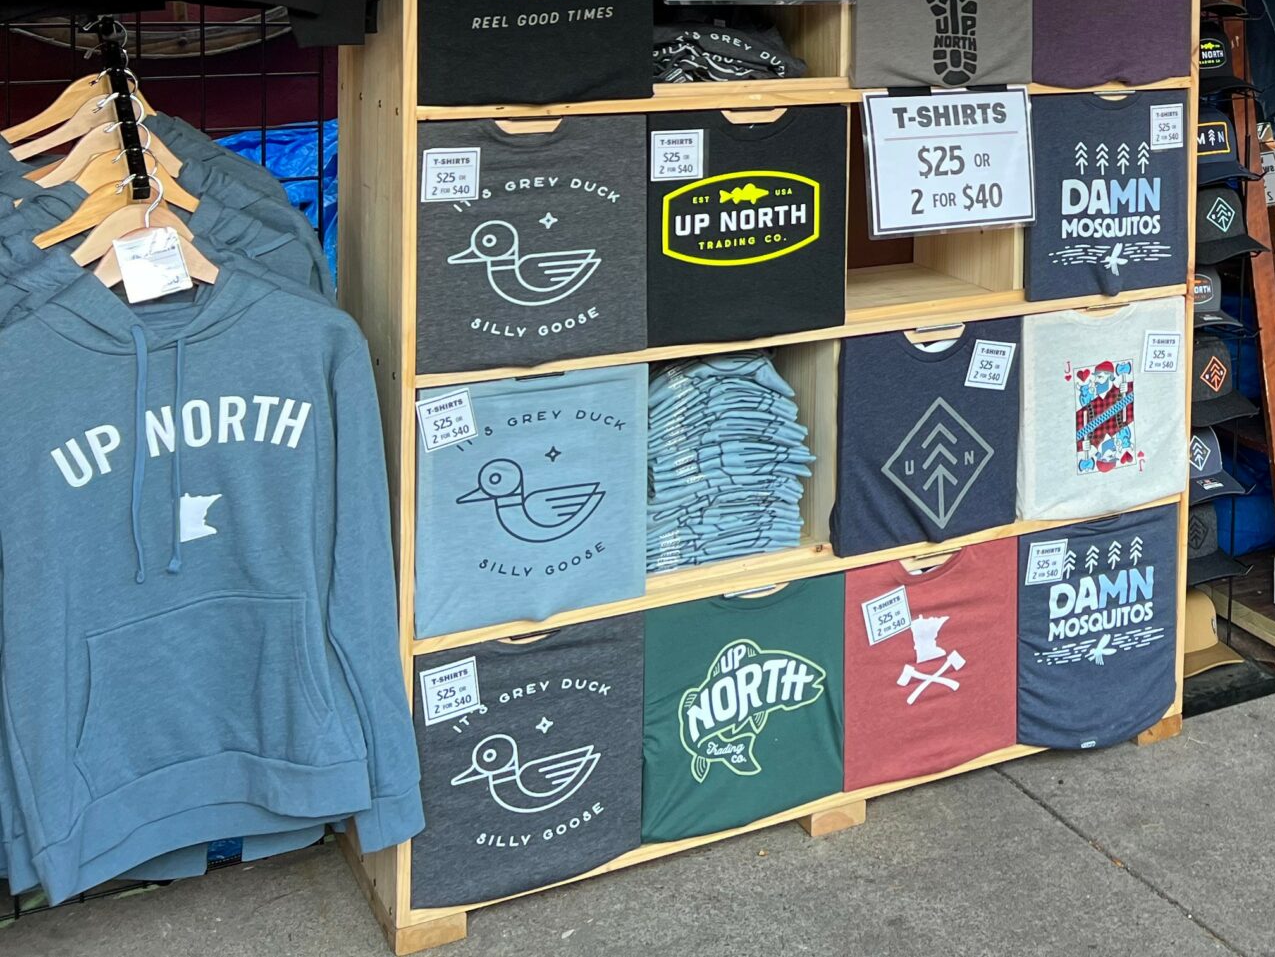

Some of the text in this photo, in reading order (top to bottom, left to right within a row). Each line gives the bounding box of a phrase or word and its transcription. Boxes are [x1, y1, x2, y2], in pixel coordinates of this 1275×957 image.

[471, 6, 614, 30] REEL GOOD TIMES
[710, 32, 752, 51] GREY
[933, 34, 977, 52] NORTH
[892, 102, 1007, 129] T-SHIRTS
[660, 138, 693, 146] T-SHIRTS
[663, 152, 680, 163] $25
[917, 145, 990, 178] $25 OR
[436, 172, 456, 184] $25
[659, 164, 694, 174] 2 $40
[432, 185, 470, 196] 2 $40
[504, 176, 620, 204] GREY DUCK
[692, 187, 792, 204] EST USA
[910, 182, 1003, 215] 2 FOR $40
[1061, 177, 1161, 216] DAMN
[674, 204, 807, 236] UP NORTH
[1061, 214, 1161, 239] MOSQUITOS
[698, 234, 787, 250] TRADING CO.
[470, 306, 600, 337] SILLY GOOSE
[981, 348, 1006, 356] T-SHIRTS
[979, 360, 993, 370] $25
[1064, 361, 1072, 374] J
[973, 370, 1000, 381] 2 $40
[426, 398, 463, 414] T-SHIRTS
[433, 416, 453, 431] $25
[507, 410, 627, 432] GREY DUCK
[50, 394, 312, 488] UP NORTH
[432, 424, 470, 444] 2 $40
[905, 450, 976, 476] U N
[480, 542, 605, 577] SILLY GOOSE
[1048, 566, 1154, 618] DAMN
[873, 596, 900, 612] T-SHIRTS
[877, 617, 906, 636] 2 $40
[878, 612, 893, 626] $25
[1048, 602, 1154, 642] MOSQUITOS
[720, 644, 746, 674] UP
[431, 668, 468, 685] T-SHIRTS
[436, 686, 456, 701] $25
[499, 678, 611, 703] GREY DUCK
[688, 658, 814, 742] NORTH
[434, 705, 440, 714] 2
[454, 694, 472, 708] $40
[706, 742, 745, 756] Trading
[476, 802, 604, 847] SILLY GOOSE
